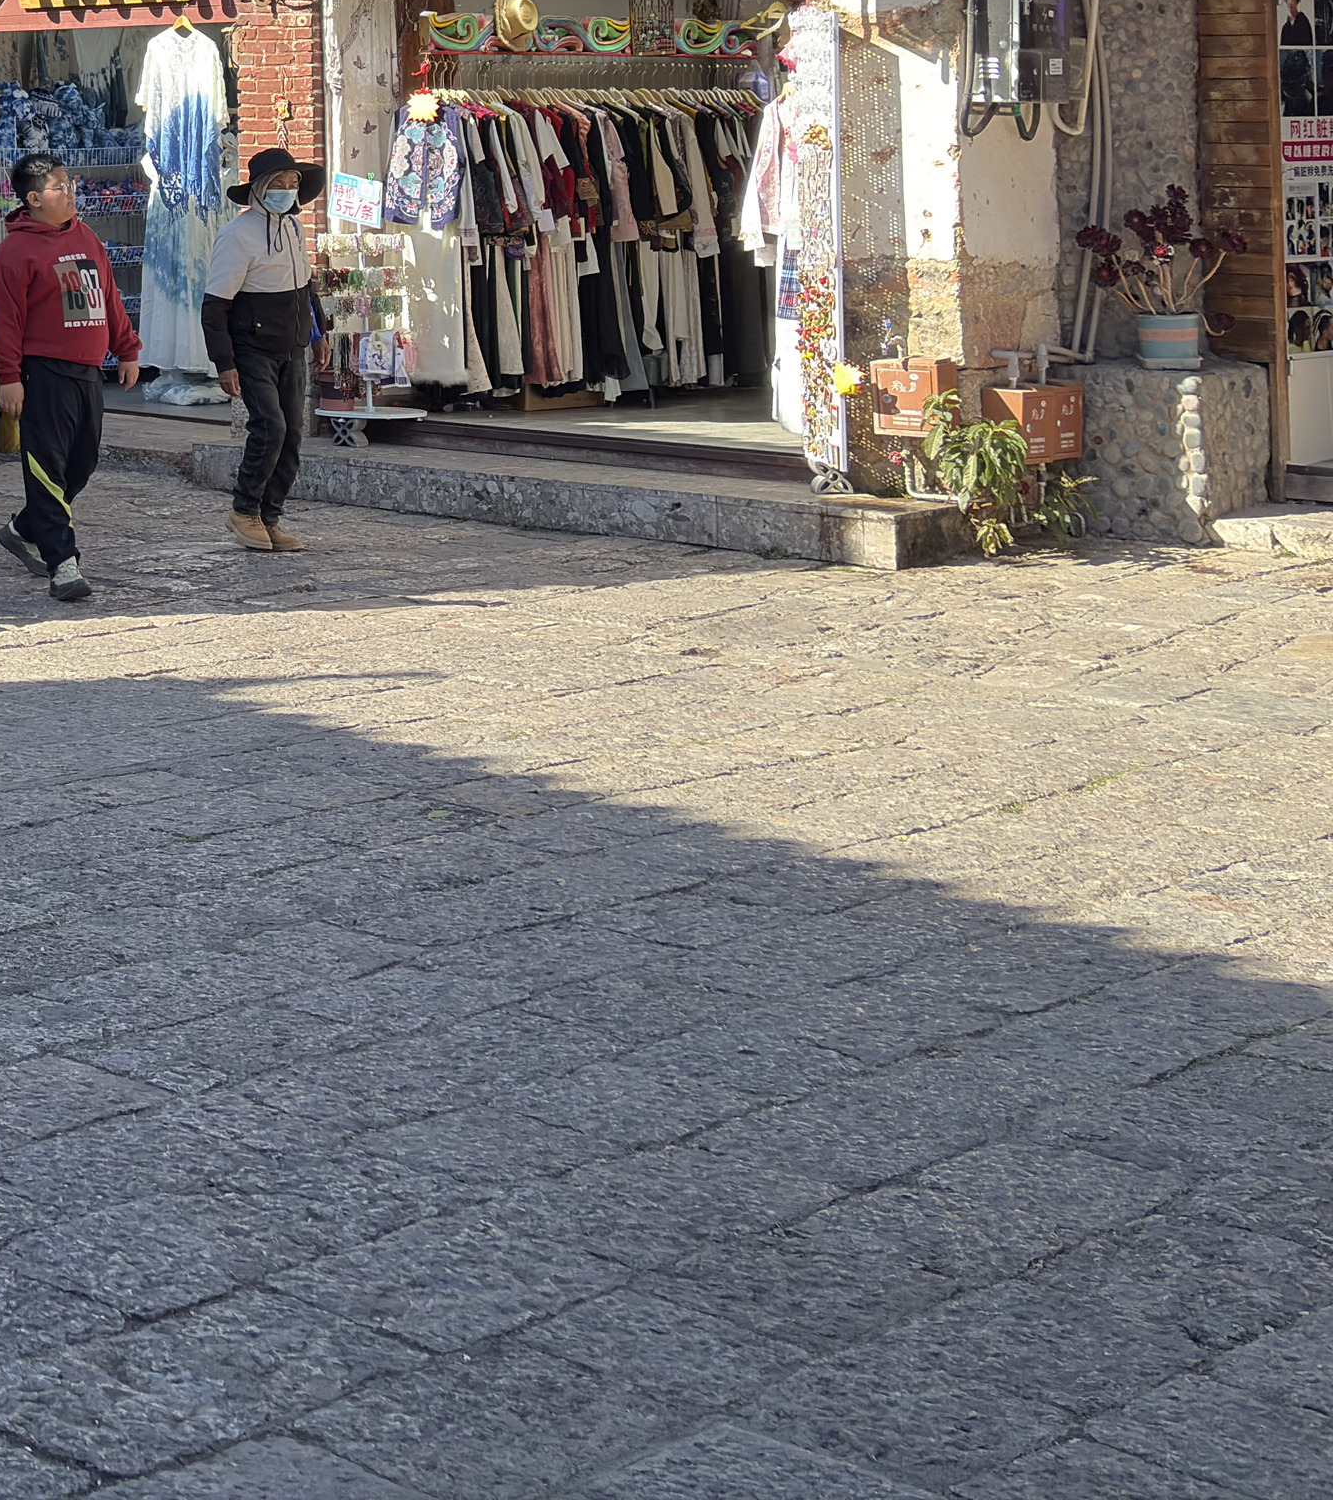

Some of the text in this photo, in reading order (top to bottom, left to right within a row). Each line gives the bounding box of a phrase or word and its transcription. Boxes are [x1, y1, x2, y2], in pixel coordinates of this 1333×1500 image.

[1284, 144, 1333, 158] 可以睡觉的
[335, 198, 374, 221] 5元/条
